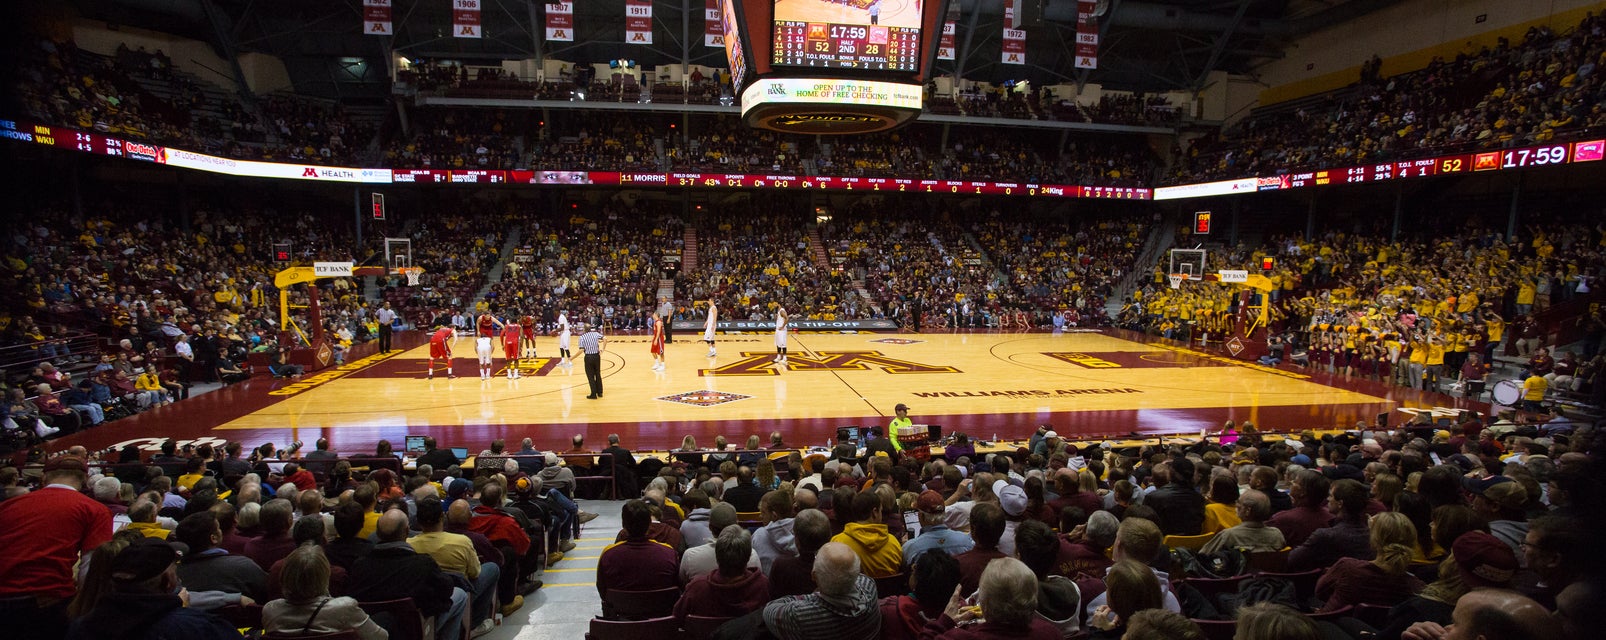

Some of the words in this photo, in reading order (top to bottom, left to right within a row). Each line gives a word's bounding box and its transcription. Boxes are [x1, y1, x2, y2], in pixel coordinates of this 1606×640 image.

[830, 26, 866, 39] 17:59
[816, 42, 830, 52] 52
[866, 45, 879, 54] 28
[838, 46, 856, 54] 2ND
[852, 92, 888, 100] CHECKING
[0, 130, 32, 142] HROWS
[34, 126, 50, 135] MIN
[76, 133, 91, 142] 2-6
[36, 136, 54, 145] WKU
[78, 143, 92, 152] 4-5
[1503, 146, 1566, 168] 17:59
[1442, 159, 1462, 172] 52
[302, 168, 318, 178] M
[322, 170, 354, 178] HEALTH
[1400, 169, 1407, 178] 4
[1418, 167, 1427, 176] 1
[912, 389, 1051, 398] WILLIAMS
